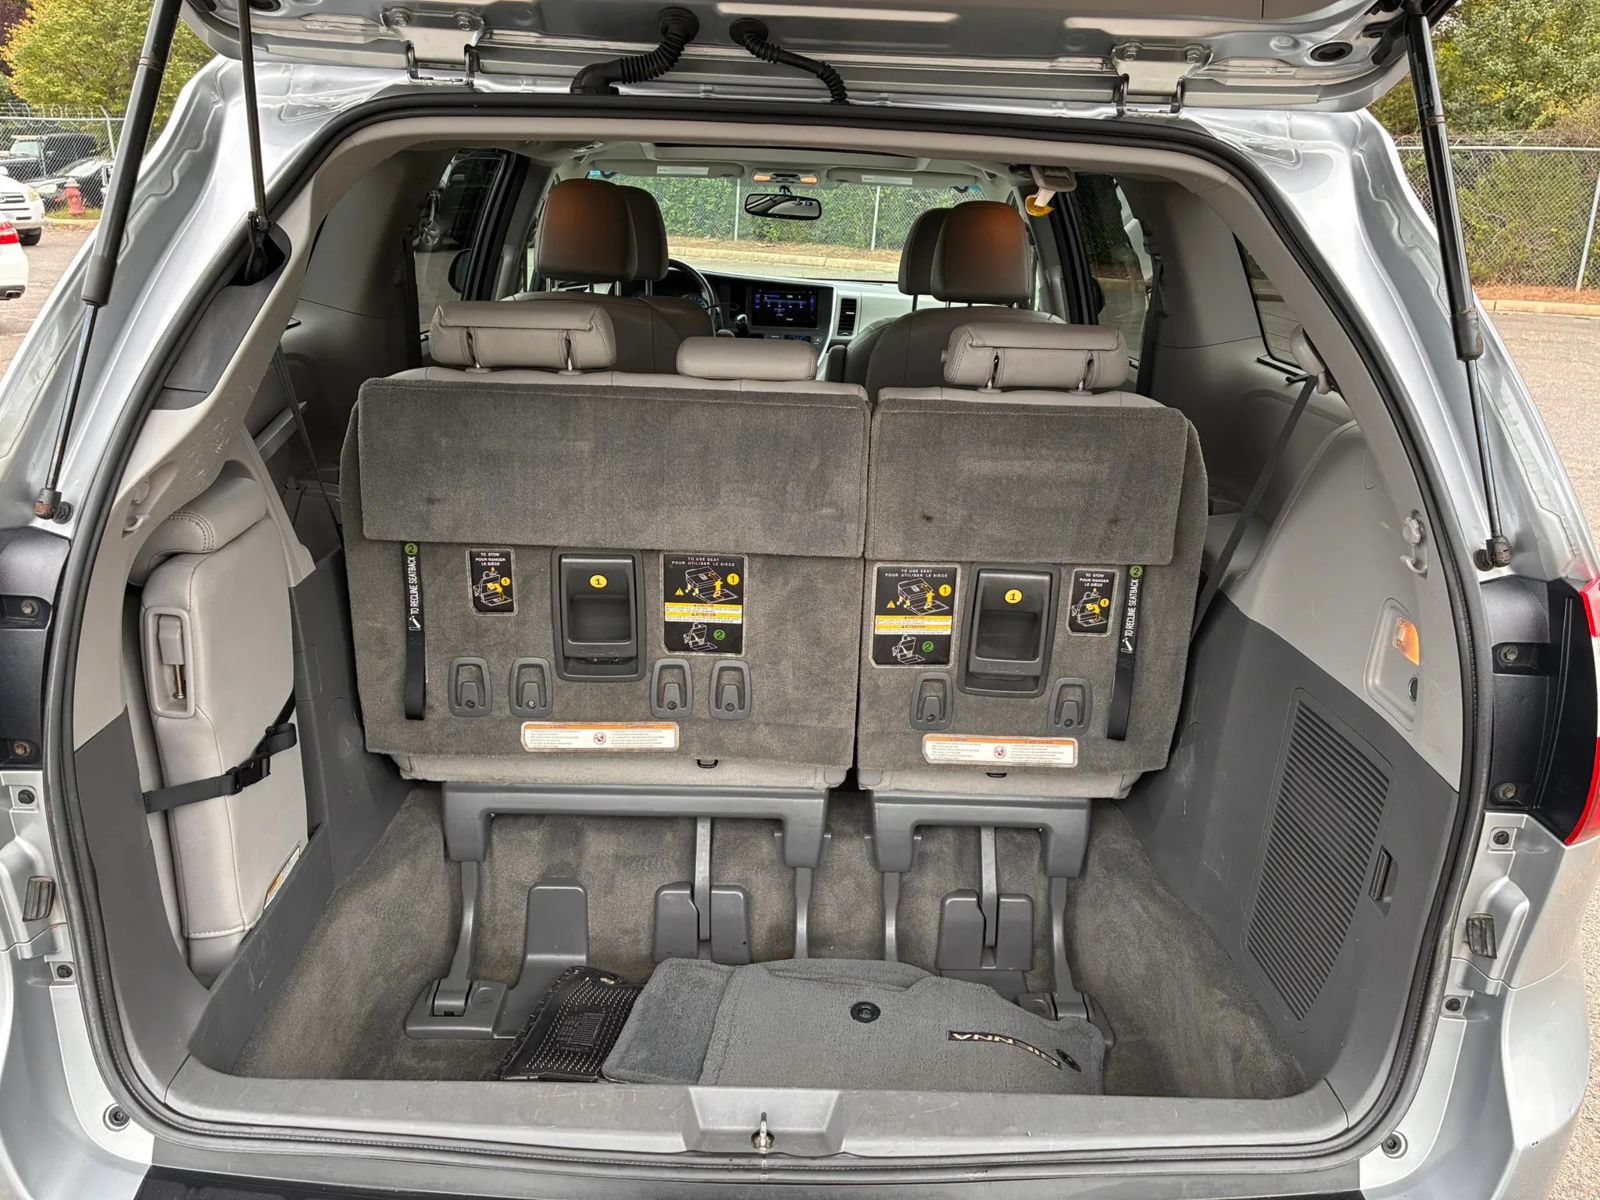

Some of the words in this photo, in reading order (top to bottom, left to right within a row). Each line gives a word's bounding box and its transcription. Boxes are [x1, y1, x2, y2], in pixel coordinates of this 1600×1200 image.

[407, 556, 418, 584] SEATBACK
[408, 584, 419, 608] RECLINE
[1128, 578, 1140, 606] SEATBACK
[410, 607, 420, 615] TO
[1125, 606, 1137, 630] RECLINE
[1124, 628, 1134, 637] TO
